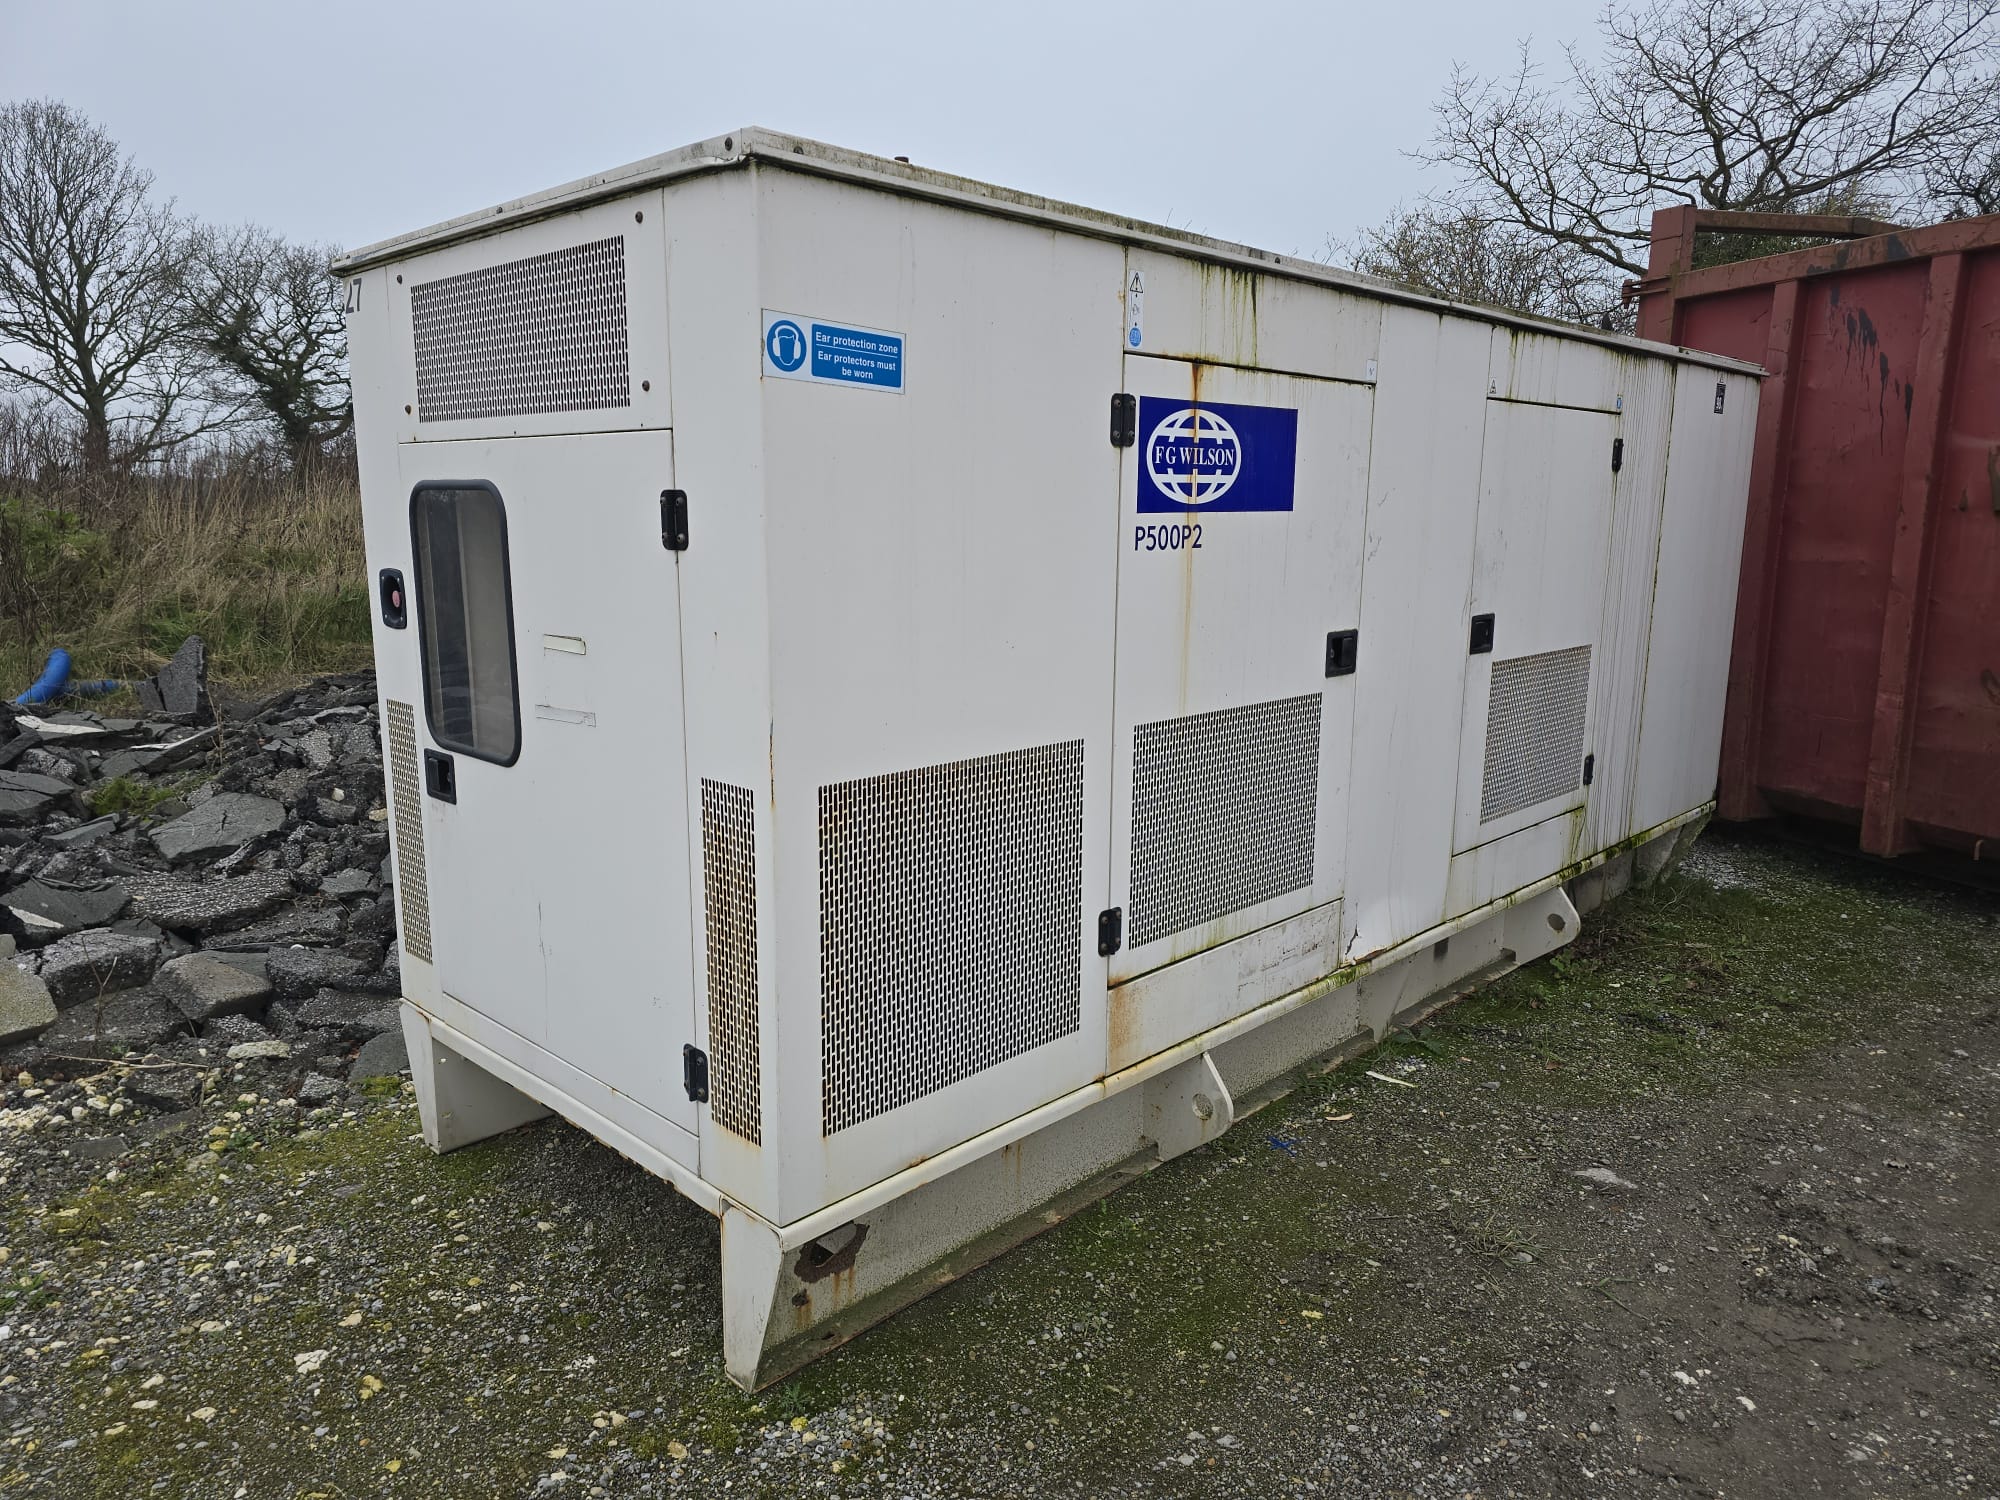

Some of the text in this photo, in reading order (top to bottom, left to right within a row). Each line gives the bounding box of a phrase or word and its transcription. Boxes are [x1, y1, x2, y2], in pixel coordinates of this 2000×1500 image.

[816, 331, 898, 354] Ear protection zone
[818, 351, 896, 371] Ear protectors must
[842, 367, 874, 380] be worn
[1155, 446, 1234, 466] FG WILSON
[1134, 524, 1203, 551] P500P2
